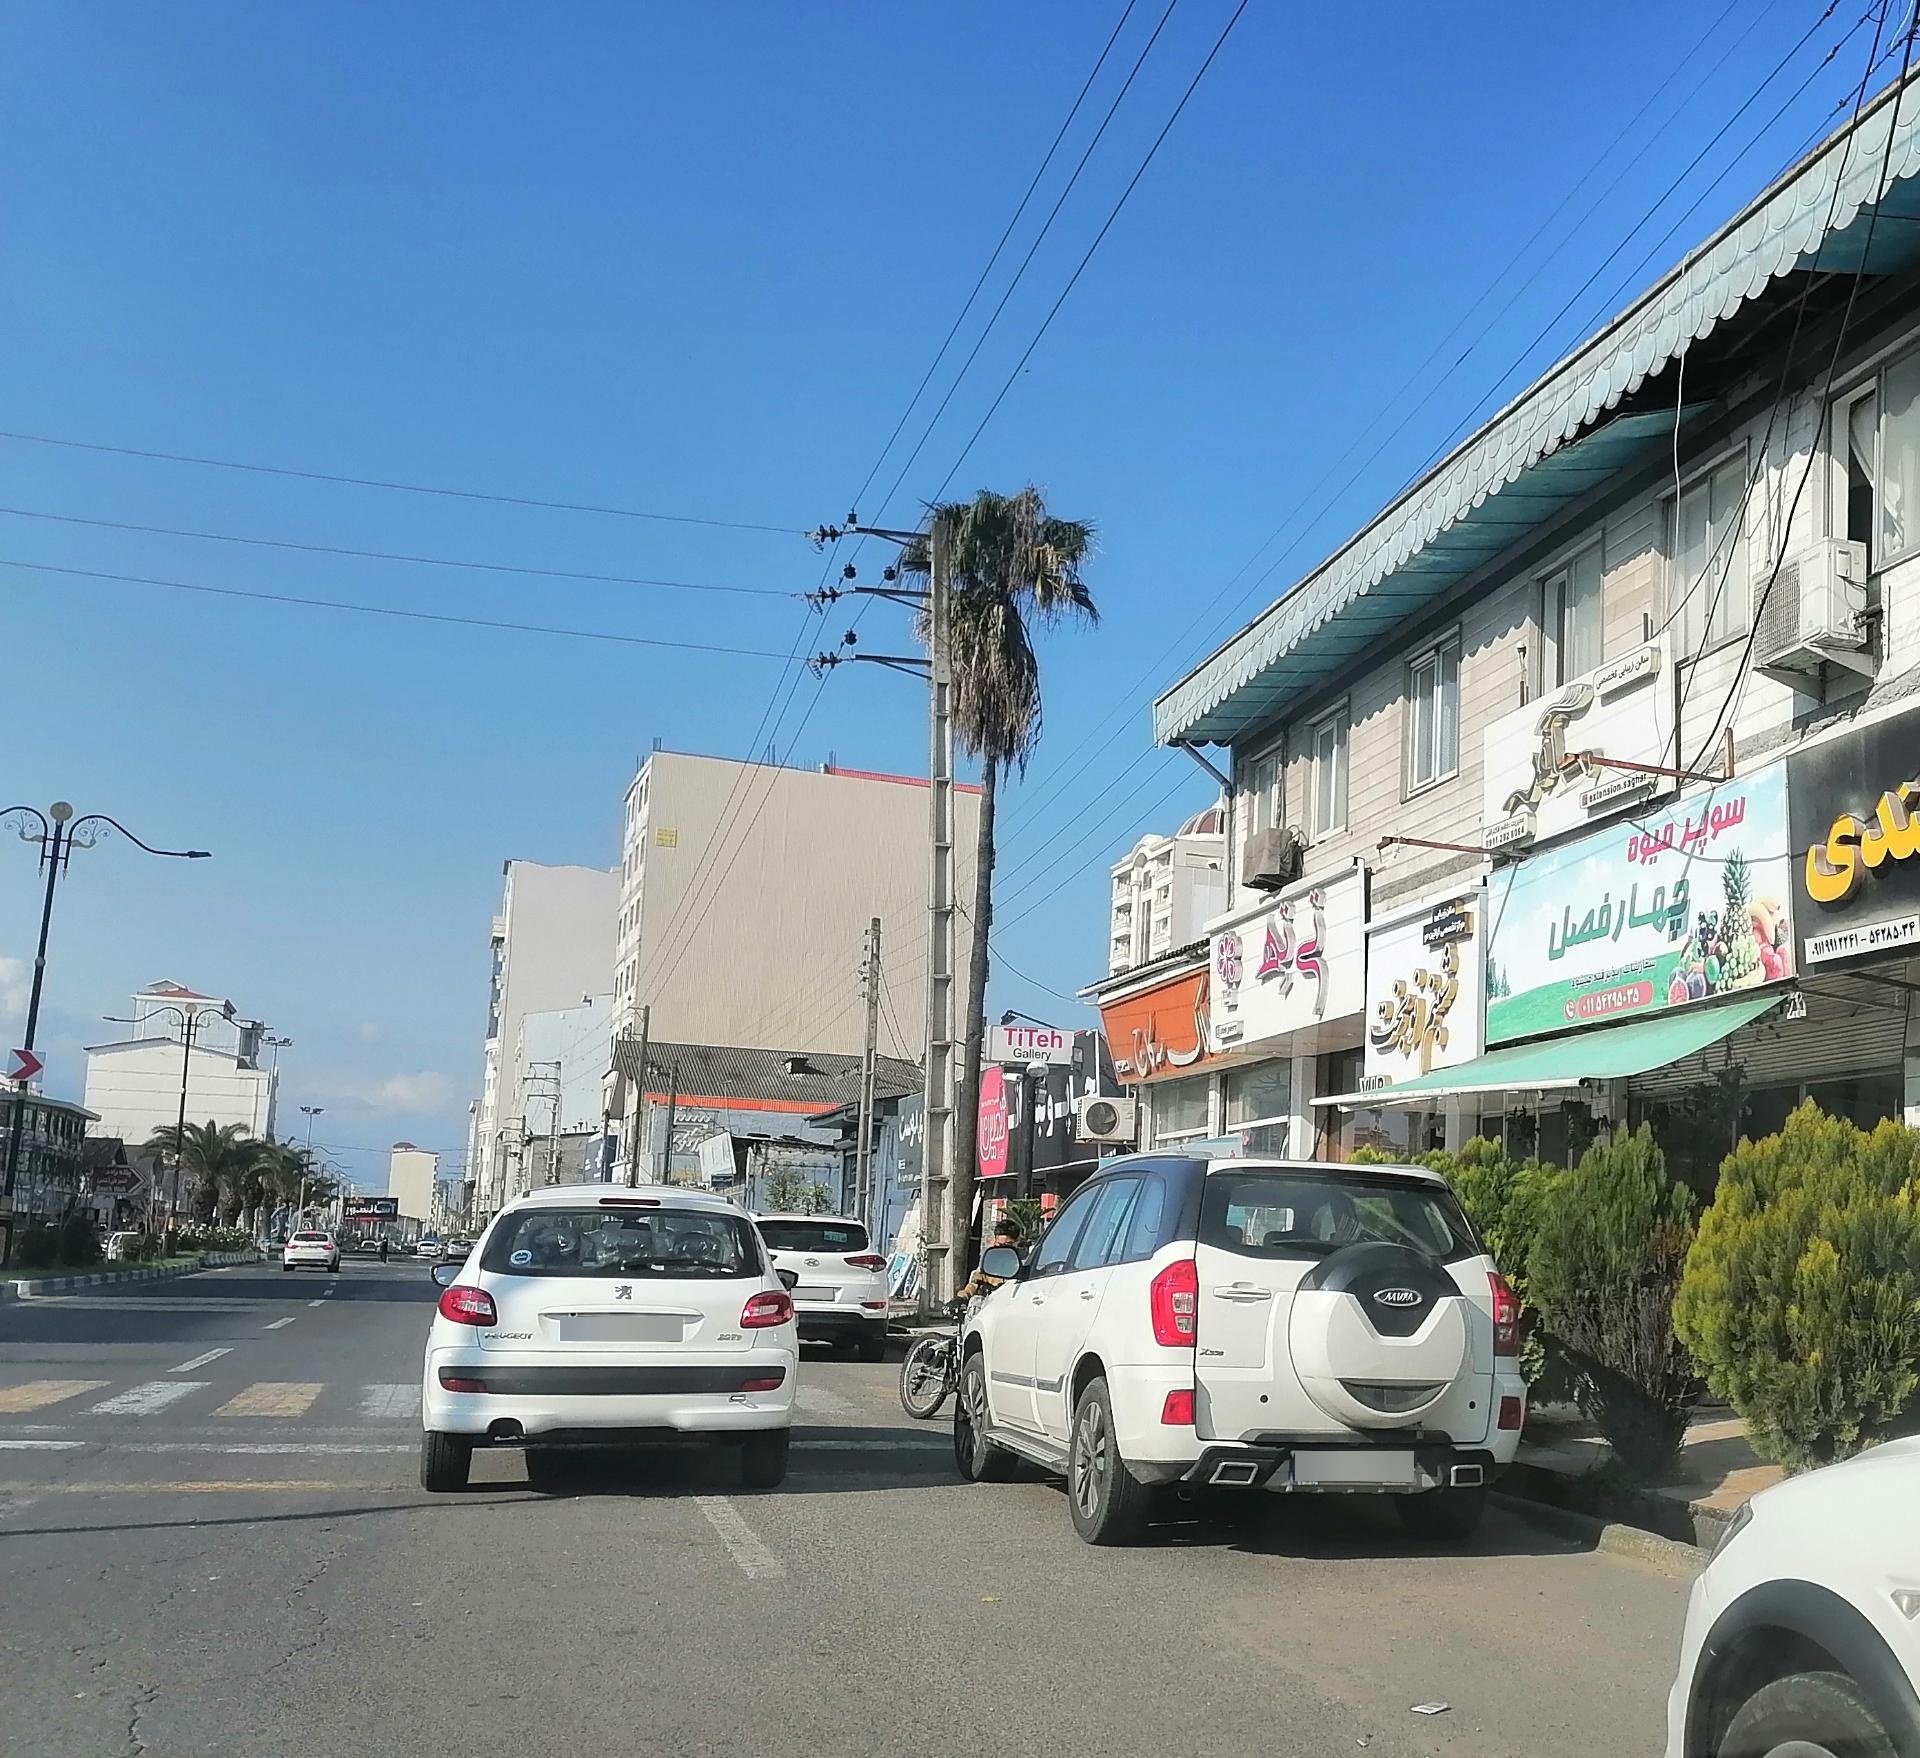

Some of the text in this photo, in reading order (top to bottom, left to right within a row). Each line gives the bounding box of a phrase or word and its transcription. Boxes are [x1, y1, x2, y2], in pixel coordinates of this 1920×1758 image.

[1627, 797, 1746, 865] سوپر میوه
[1003, 1027, 1063, 1049] TiTeh
[1013, 1047, 1052, 1062] Gallery
